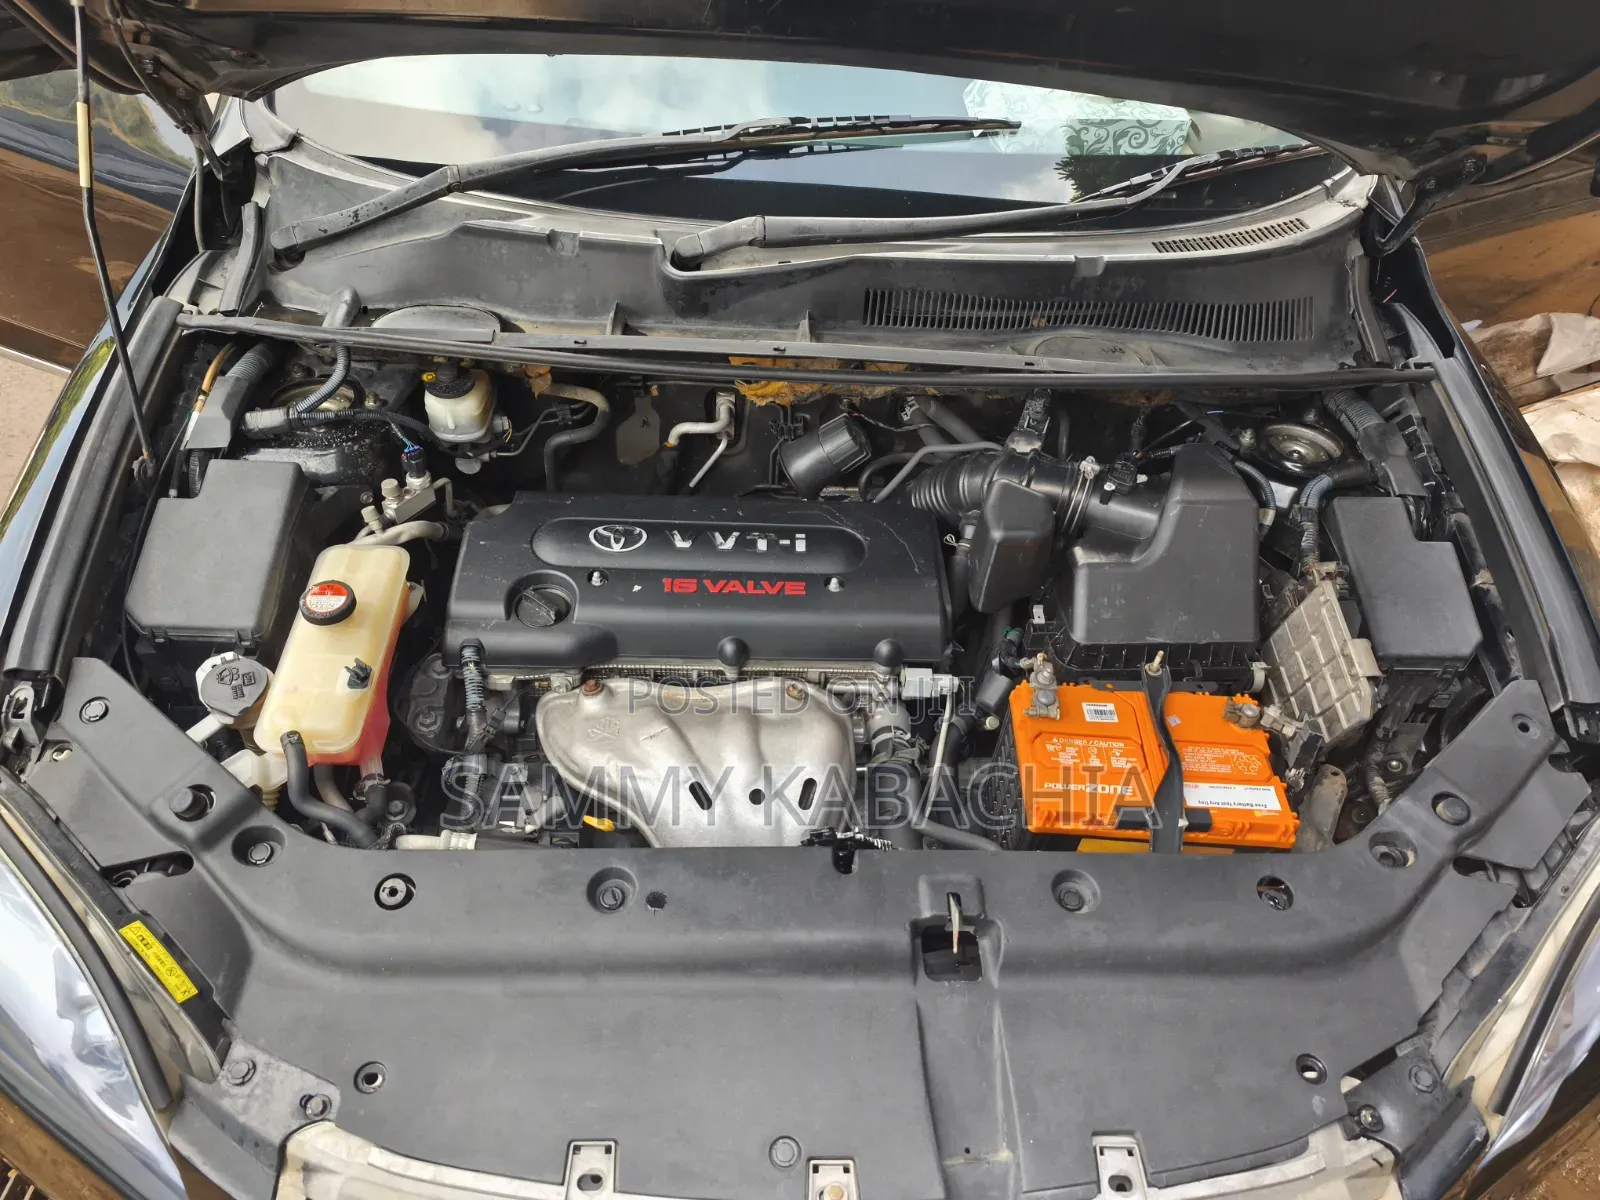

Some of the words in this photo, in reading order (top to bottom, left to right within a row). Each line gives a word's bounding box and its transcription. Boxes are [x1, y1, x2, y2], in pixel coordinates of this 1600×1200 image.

[663, 577, 698, 594] 16
[703, 578, 806, 596] VALVE
[1093, 740, 1125, 748] CAUTION
